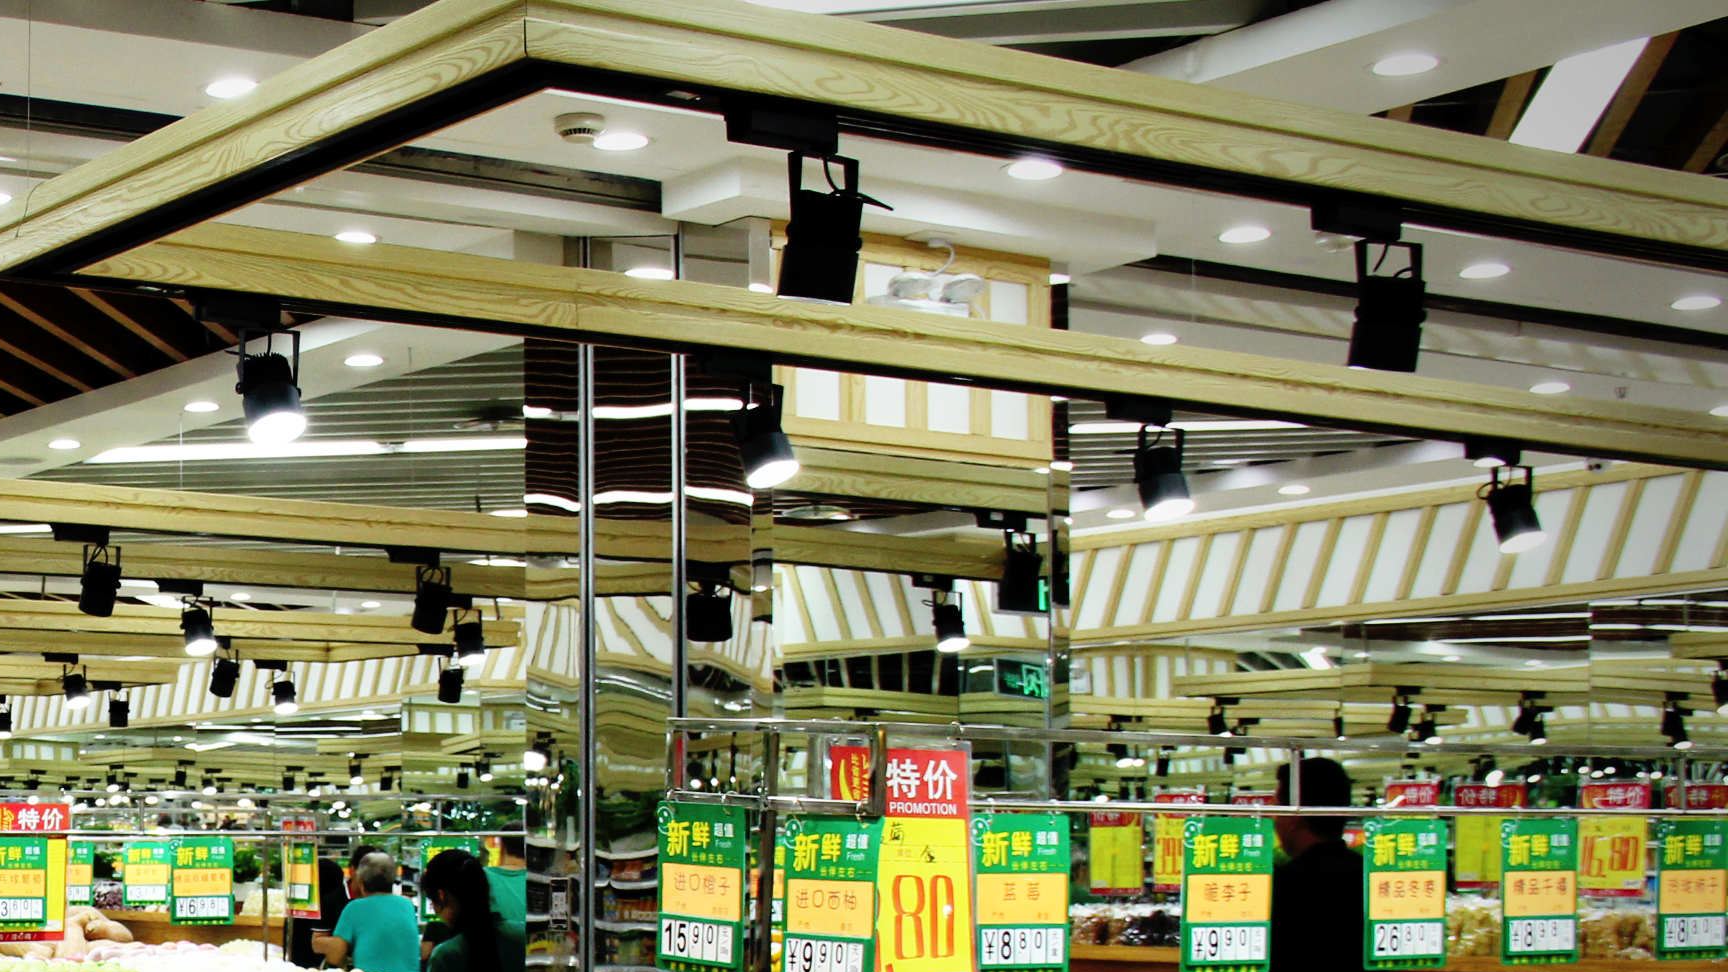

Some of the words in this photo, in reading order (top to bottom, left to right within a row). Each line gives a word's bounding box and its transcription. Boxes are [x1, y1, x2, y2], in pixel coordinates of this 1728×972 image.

[886, 759, 958, 800] 特价
[18, 808, 63, 830] 特价
[889, 801, 957, 816] PROMOTION
[667, 820, 710, 856] 新鲜
[714, 823, 734, 837] 超值
[793, 833, 842, 871] 新鲜
[846, 834, 869, 849] 超值
[982, 831, 1033, 867] 新鲜
[1036, 831, 1059, 845] 超值
[1193, 834, 1240, 868] 新鲜
[1373, 833, 1416, 866] 新鲜
[1508, 834, 1549, 866] 新鲜
[1664, 834, 1703, 865] 新鲜
[176, 846, 209, 866] 新鲜
[846, 852, 865, 861] Fresh
[674, 872, 730, 896] 进口橙子
[796, 889, 857, 910] 进口西柚
[1204, 882, 1251, 902] 脆李子
